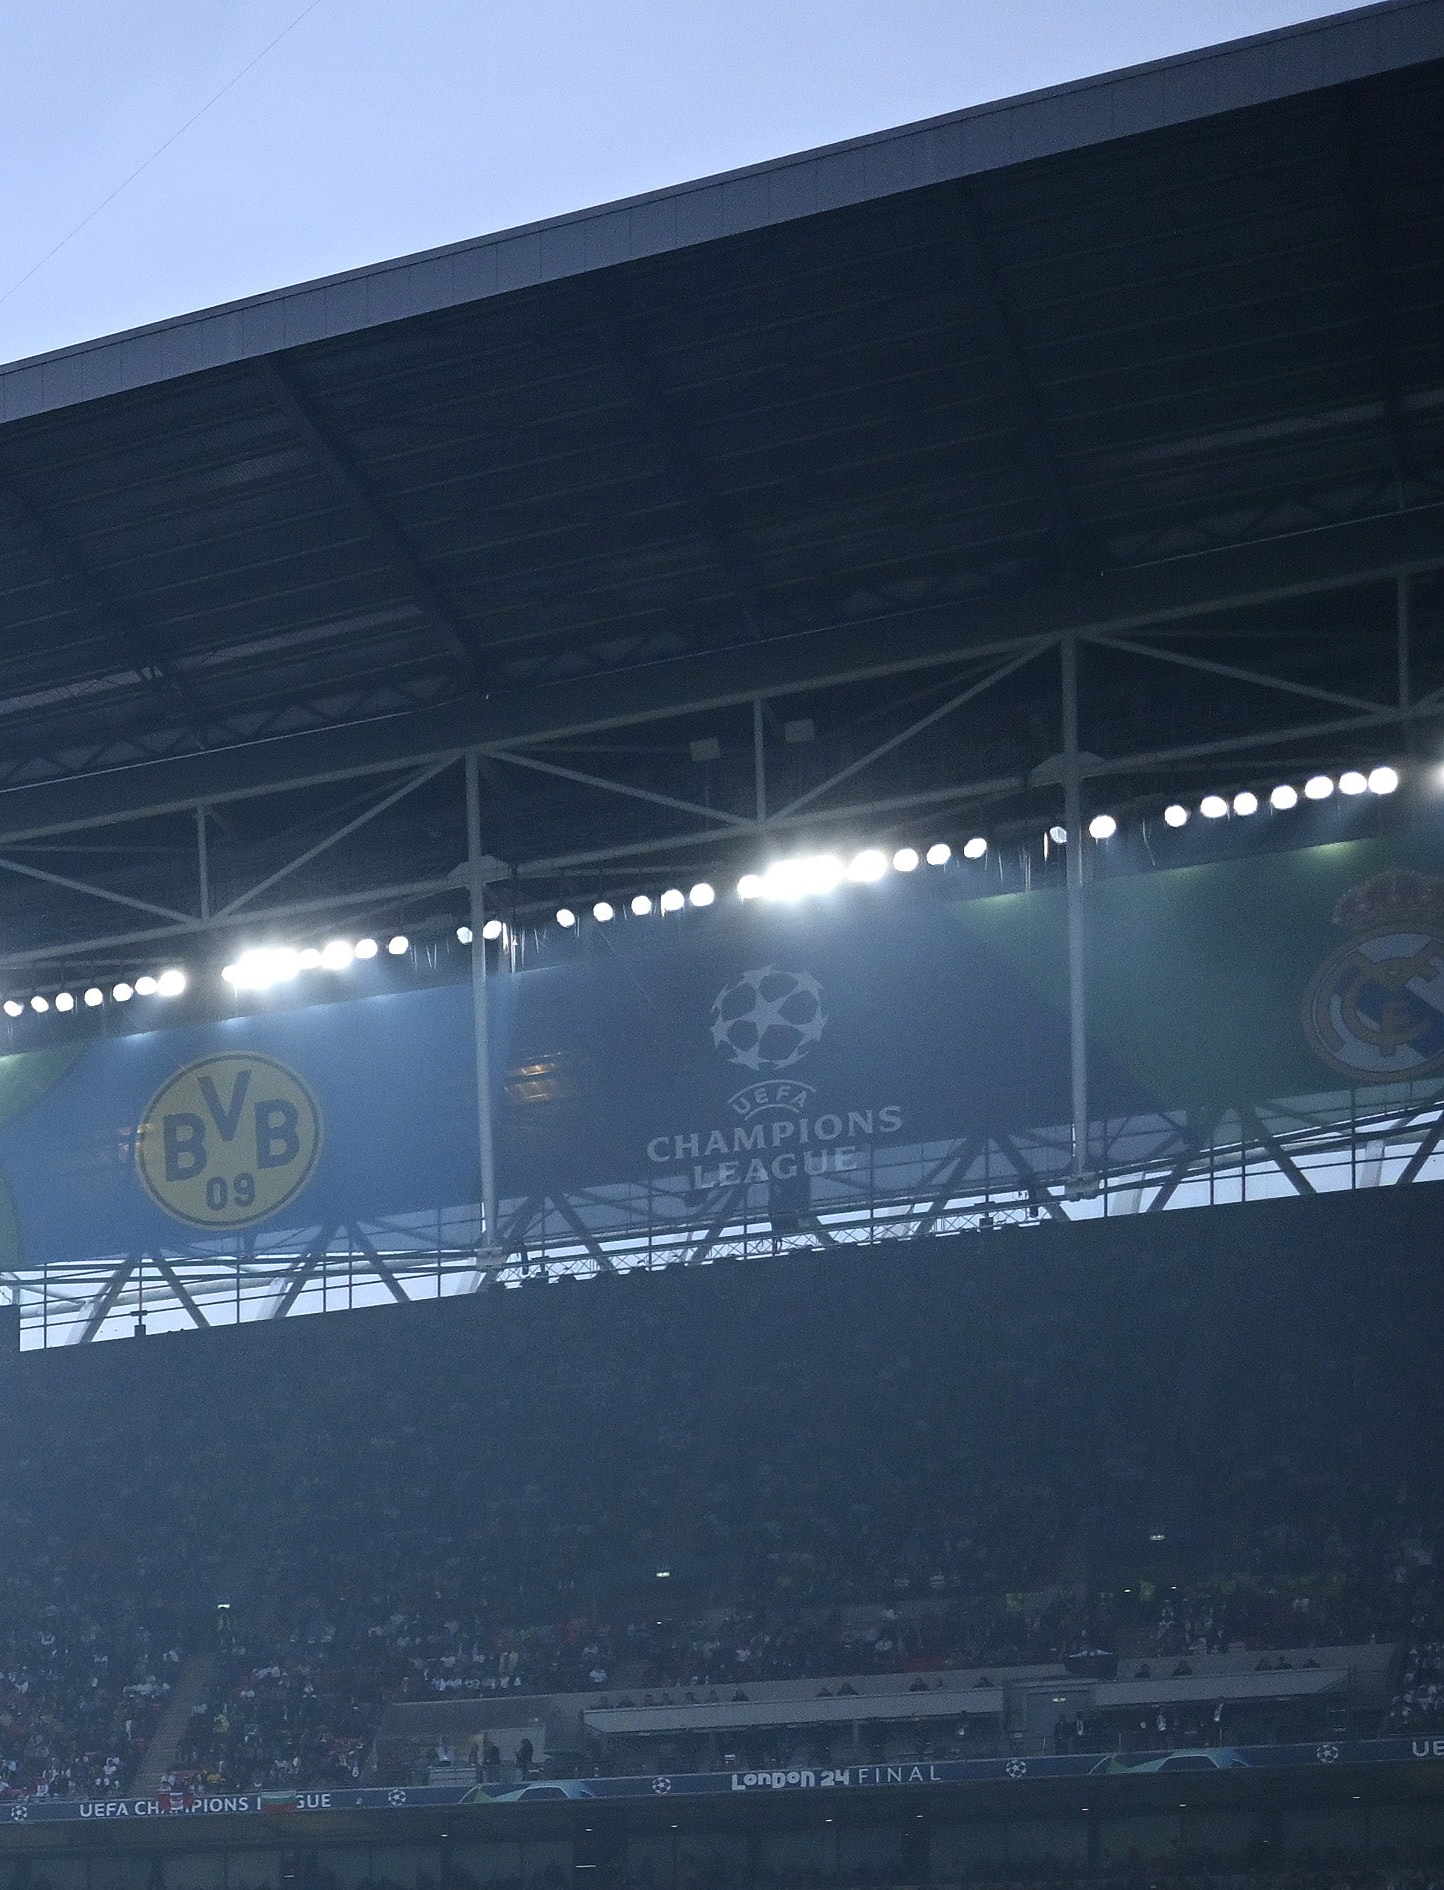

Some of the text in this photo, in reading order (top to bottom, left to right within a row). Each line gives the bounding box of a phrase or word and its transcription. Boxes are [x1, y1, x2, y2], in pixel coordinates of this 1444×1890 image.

[732, 1085, 809, 1115] UEFA
[163, 1069, 300, 1183] BVB
[647, 1105, 903, 1163] CHAMPIONS
[693, 1144, 859, 1190] LEAGUE
[205, 1172, 256, 1211] 09
[732, 1765, 941, 1790] London 24 FINAL
[80, 1792, 332, 1818] UEFA CHPIONS LGUE
